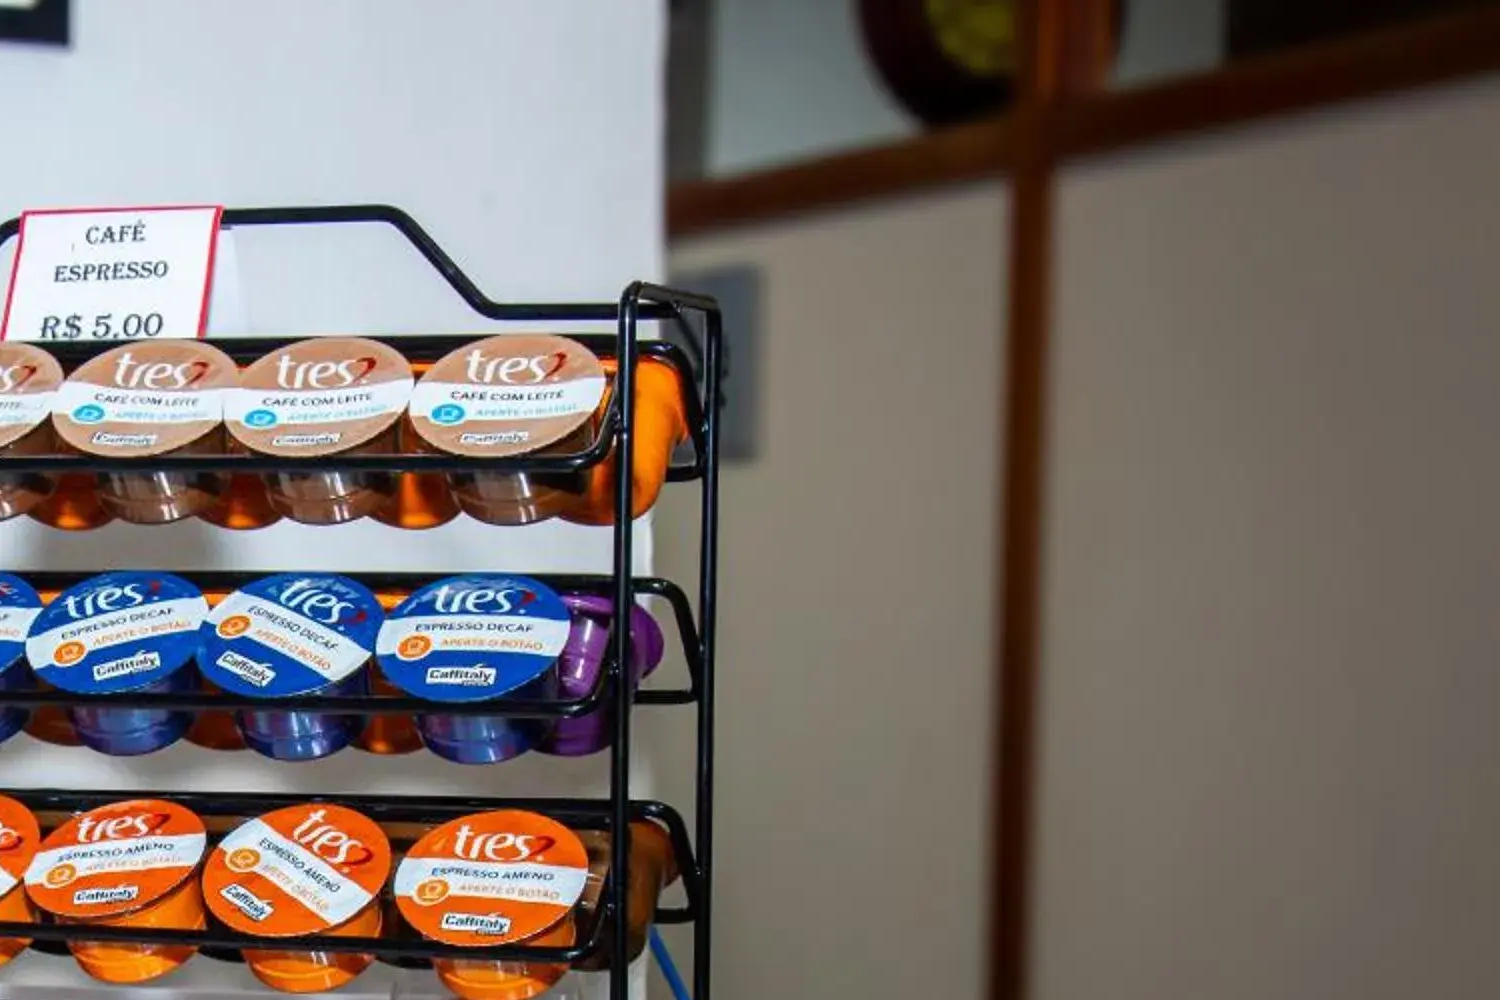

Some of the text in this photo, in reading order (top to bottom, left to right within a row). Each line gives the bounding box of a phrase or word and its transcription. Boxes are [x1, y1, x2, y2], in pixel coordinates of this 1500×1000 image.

[85, 219, 146, 245] CAFÉ
[54, 261, 169, 283] ESPRESSO
[40, 313, 83, 339] R$
[277, 354, 356, 389] tres
[467, 350, 548, 383] tres
[63, 583, 144, 618] tres
[435, 585, 515, 613] tres
[415, 623, 533, 632] ESPRESSO DECAF
[429, 669, 492, 681] Caffitaly
[78, 814, 151, 842] tres
[454, 825, 533, 860] tres
[432, 867, 499, 878] ESPRESSO
[446, 915, 506, 930] Caffitaly
